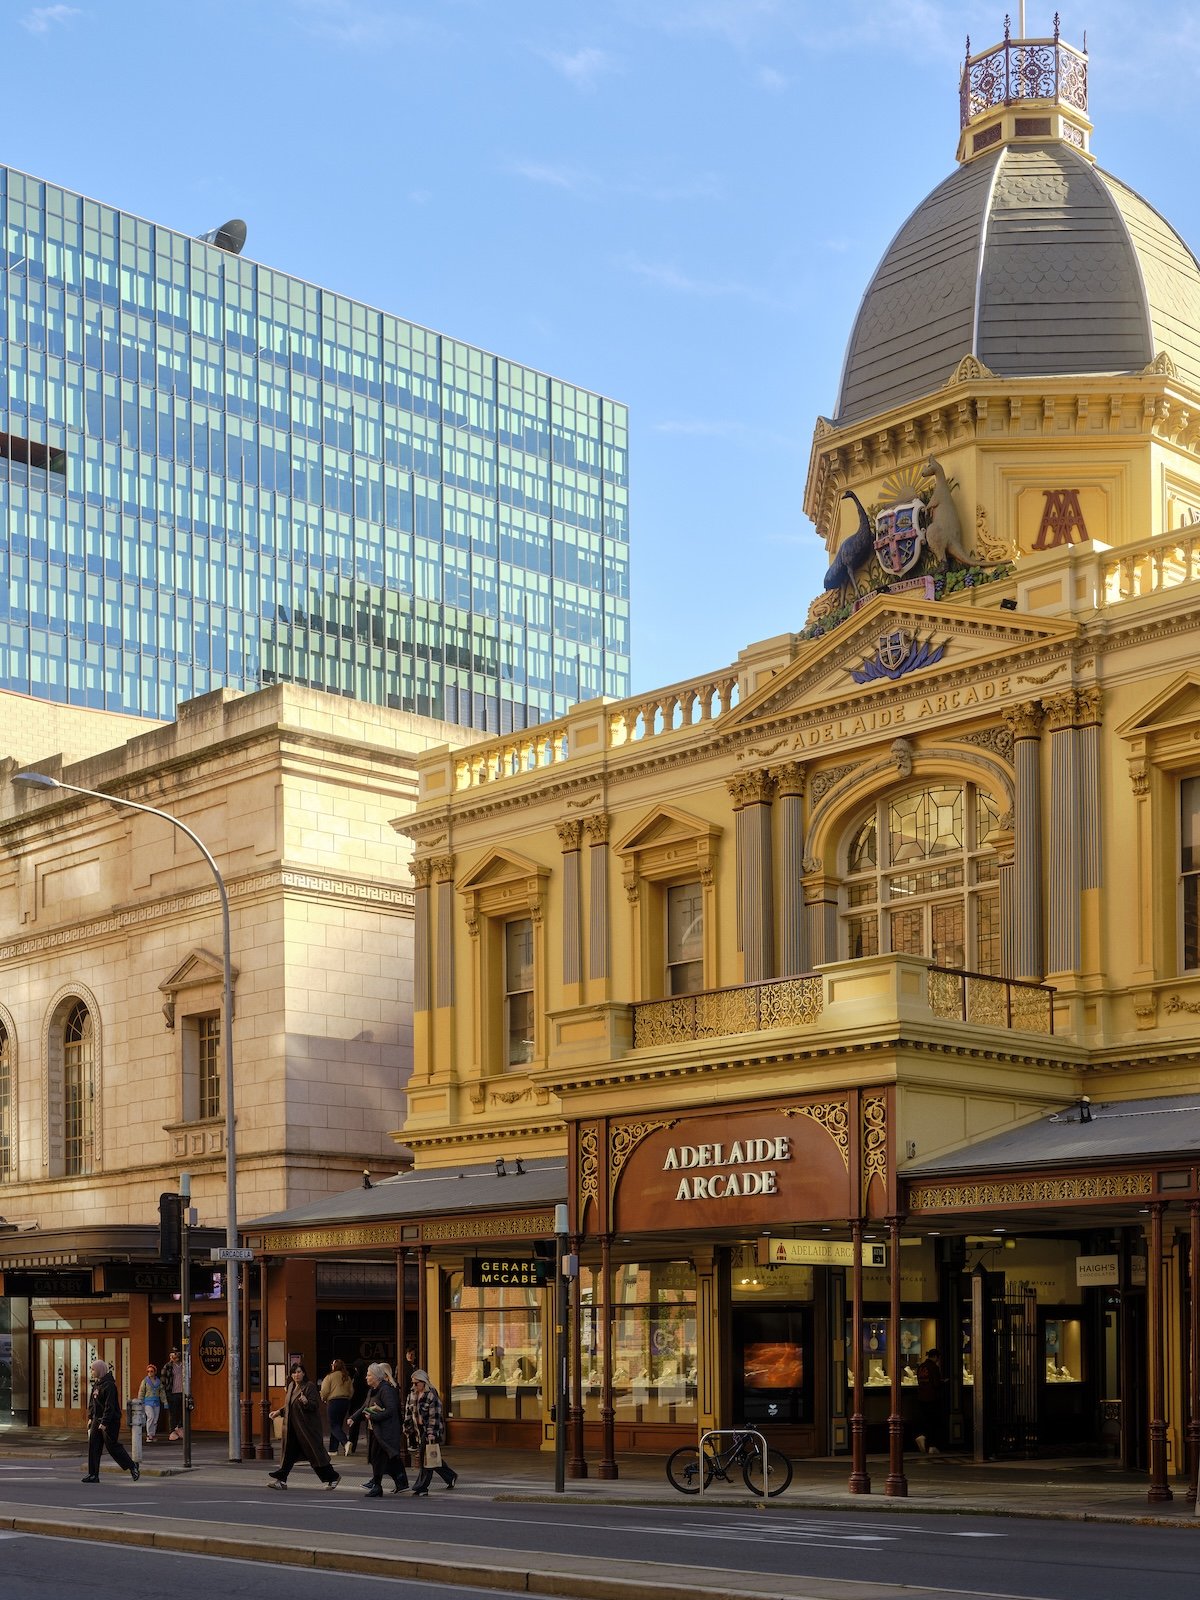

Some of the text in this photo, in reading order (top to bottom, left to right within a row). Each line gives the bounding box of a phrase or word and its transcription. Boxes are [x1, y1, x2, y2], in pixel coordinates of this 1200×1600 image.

[792, 677, 1012, 750] ADELAIDE ARCADE
[662, 1136, 791, 1171] ADELAIDE
[675, 1170, 778, 1201] ARCADE
[221, 1250, 243, 1258] ARCADE
[791, 1245, 832, 1257] ADELAIDE
[1079, 1263, 1116, 1273] HAIGH'S
[34, 1279, 82, 1291] GATSBY
[134, 1273, 179, 1286] GATSB
[200, 1346, 225, 1356] GATSBY
[56, 1364, 64, 1402] Shop.
